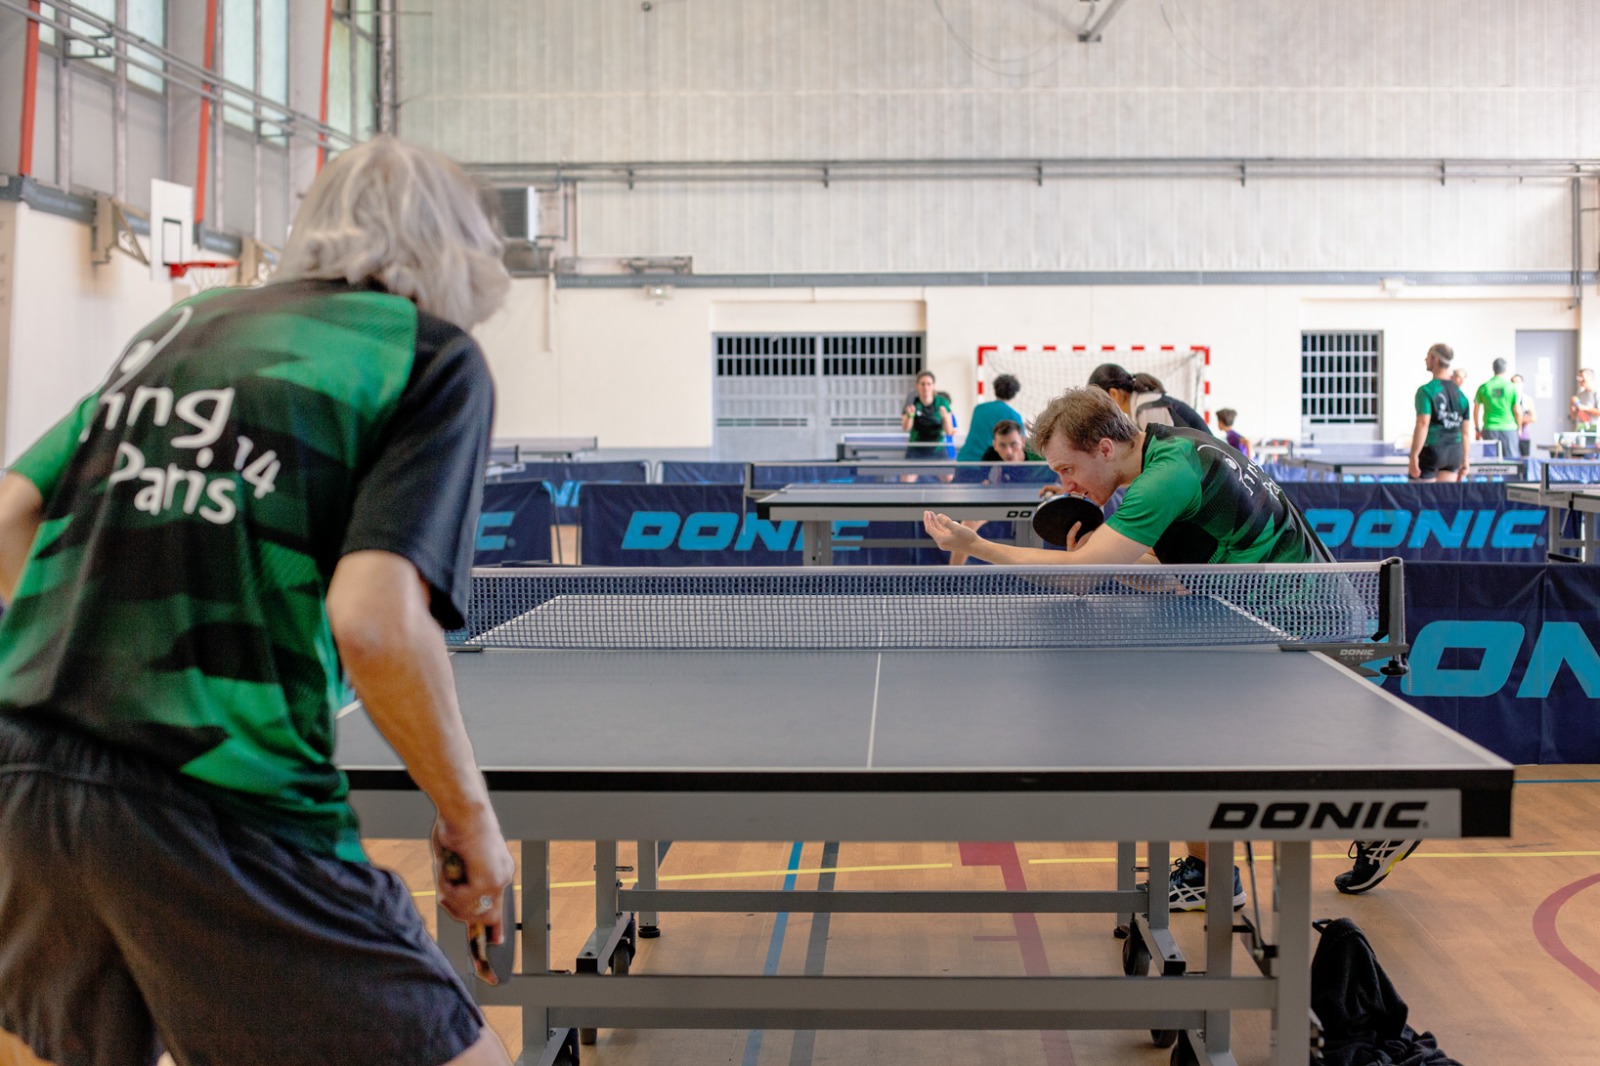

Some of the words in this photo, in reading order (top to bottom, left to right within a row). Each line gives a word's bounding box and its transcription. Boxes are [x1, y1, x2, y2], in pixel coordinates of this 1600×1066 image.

[84, 376, 236, 449] ing
[107, 441, 237, 525] Paris
[233, 435, 282, 500] 14
[1340, 648, 1375, 656] DONIC
[1208, 802, 1429, 830] DONIC
